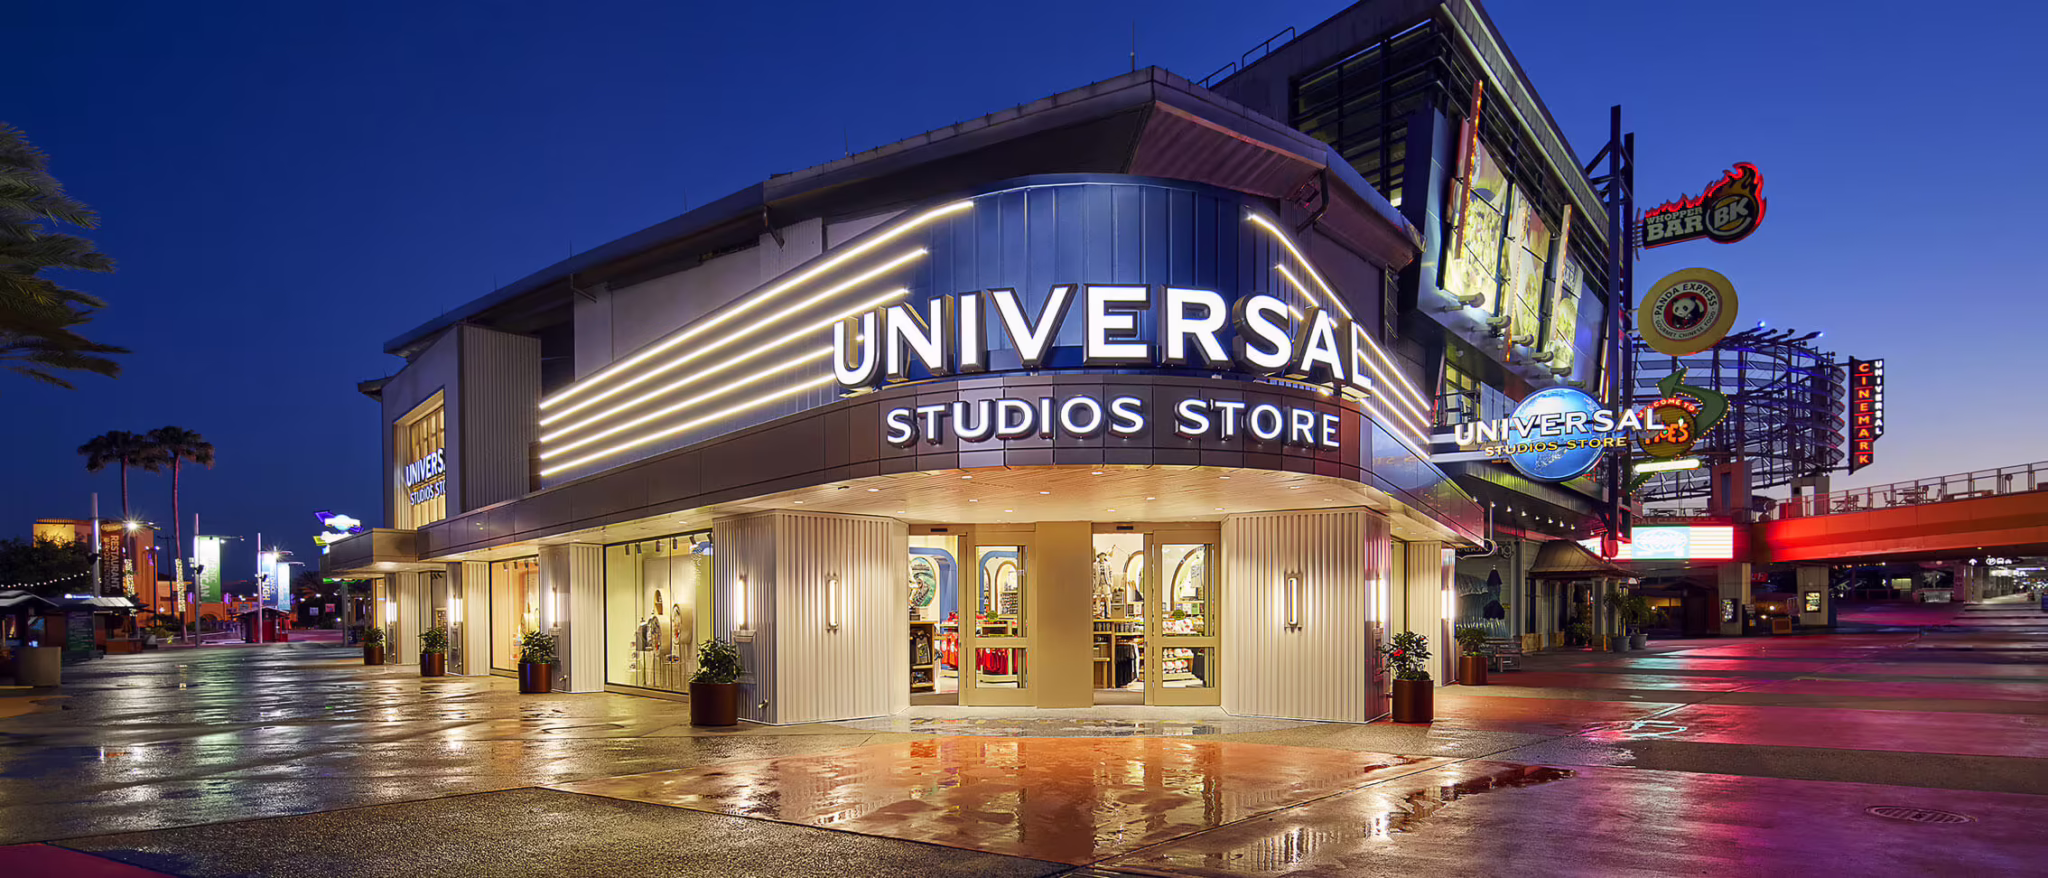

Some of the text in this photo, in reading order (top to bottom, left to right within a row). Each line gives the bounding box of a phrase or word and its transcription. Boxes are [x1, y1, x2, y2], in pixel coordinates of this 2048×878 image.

[1645, 206, 1704, 226] WHOPPER
[1646, 215, 1704, 242] BAR
[1713, 197, 1748, 230] BK
[1654, 283, 1718, 316] PANDA EXPRESS
[833, 283, 1373, 396] UNIVERSAL
[1655, 310, 1716, 338] GOURMET CHINESE FOOD
[1683, 401, 1696, 412] TO
[1857, 363, 1871, 466] CINEMARK
[1873, 359, 1883, 437] UNIVERSAL
[886, 394, 1341, 449] STUDIOS STORE
[1454, 406, 1666, 446] UNIVERSAL
[1485, 436, 1628, 457] STUDIOS STORE
[406, 448, 446, 487] UNIVERS
[409, 484, 434, 506] STUDIOS
[110, 535, 120, 589] RESTAURANT
